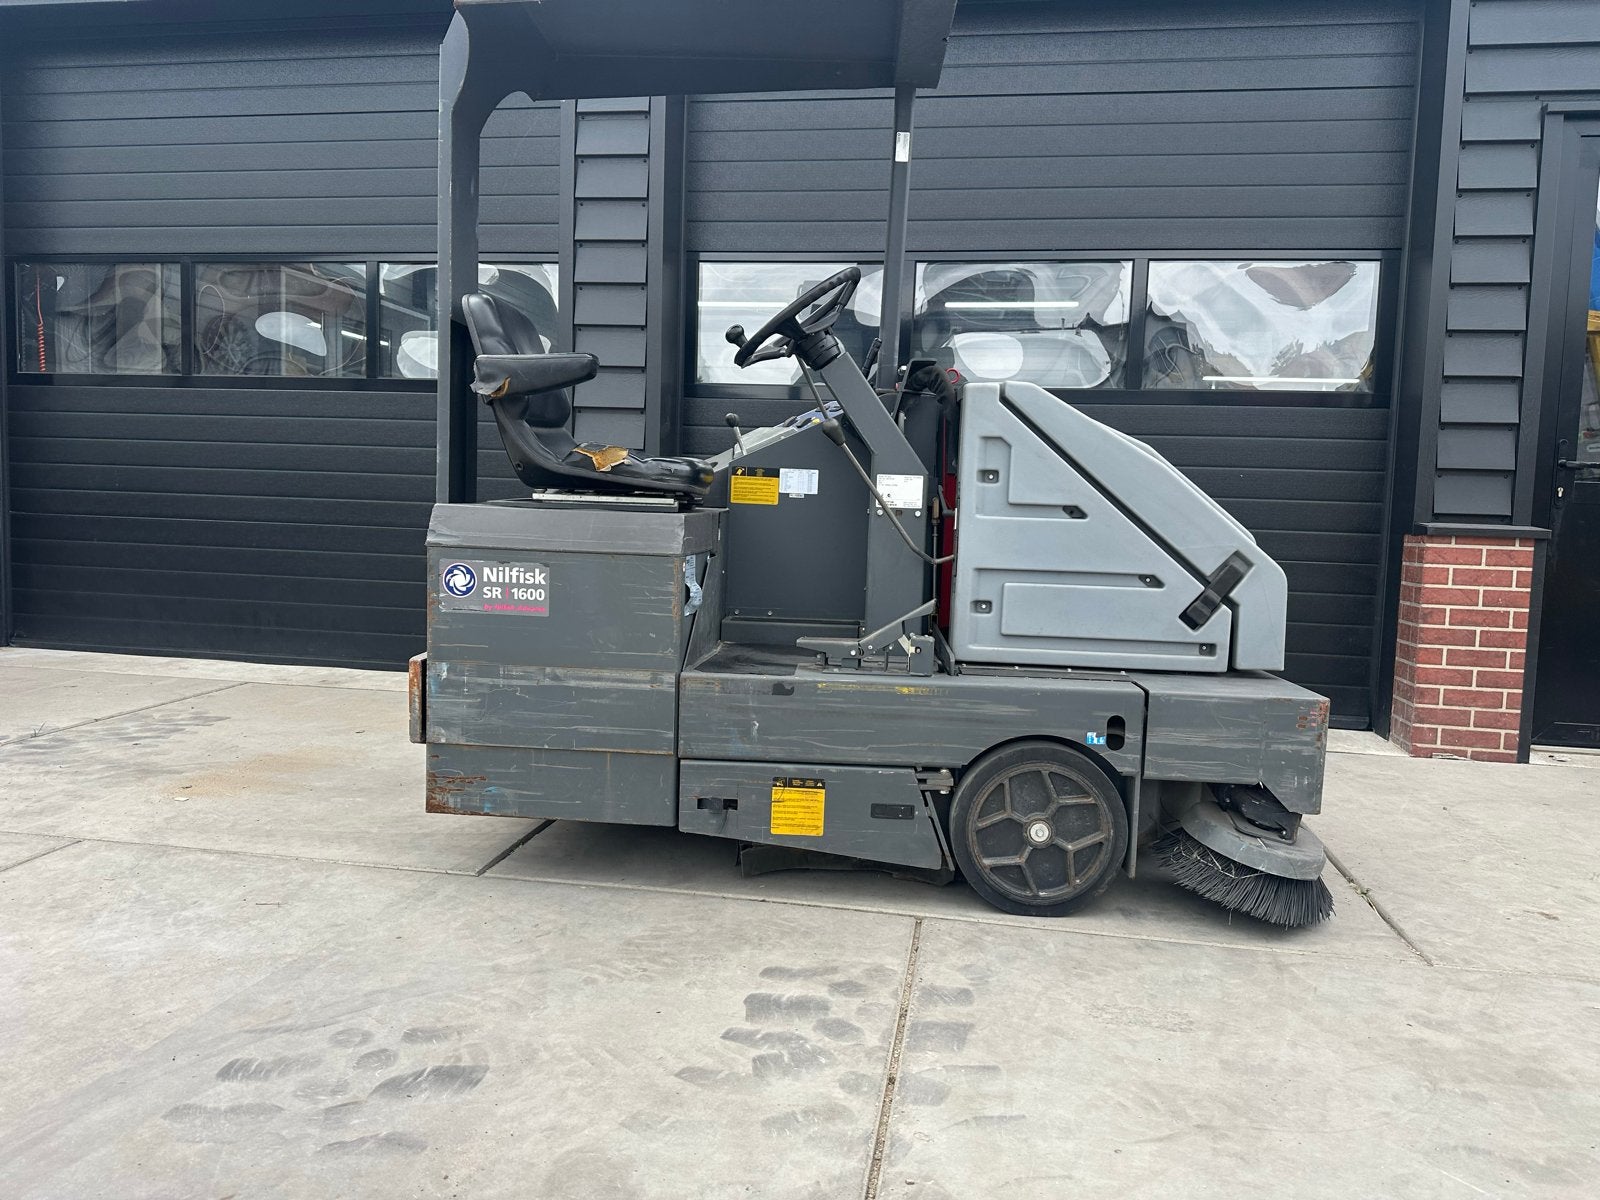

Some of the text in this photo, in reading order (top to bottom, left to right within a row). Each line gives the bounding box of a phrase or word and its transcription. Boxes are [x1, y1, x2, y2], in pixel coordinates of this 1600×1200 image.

[482, 566, 546, 585] Nilfisk
[482, 586, 545, 601] SR 1600
